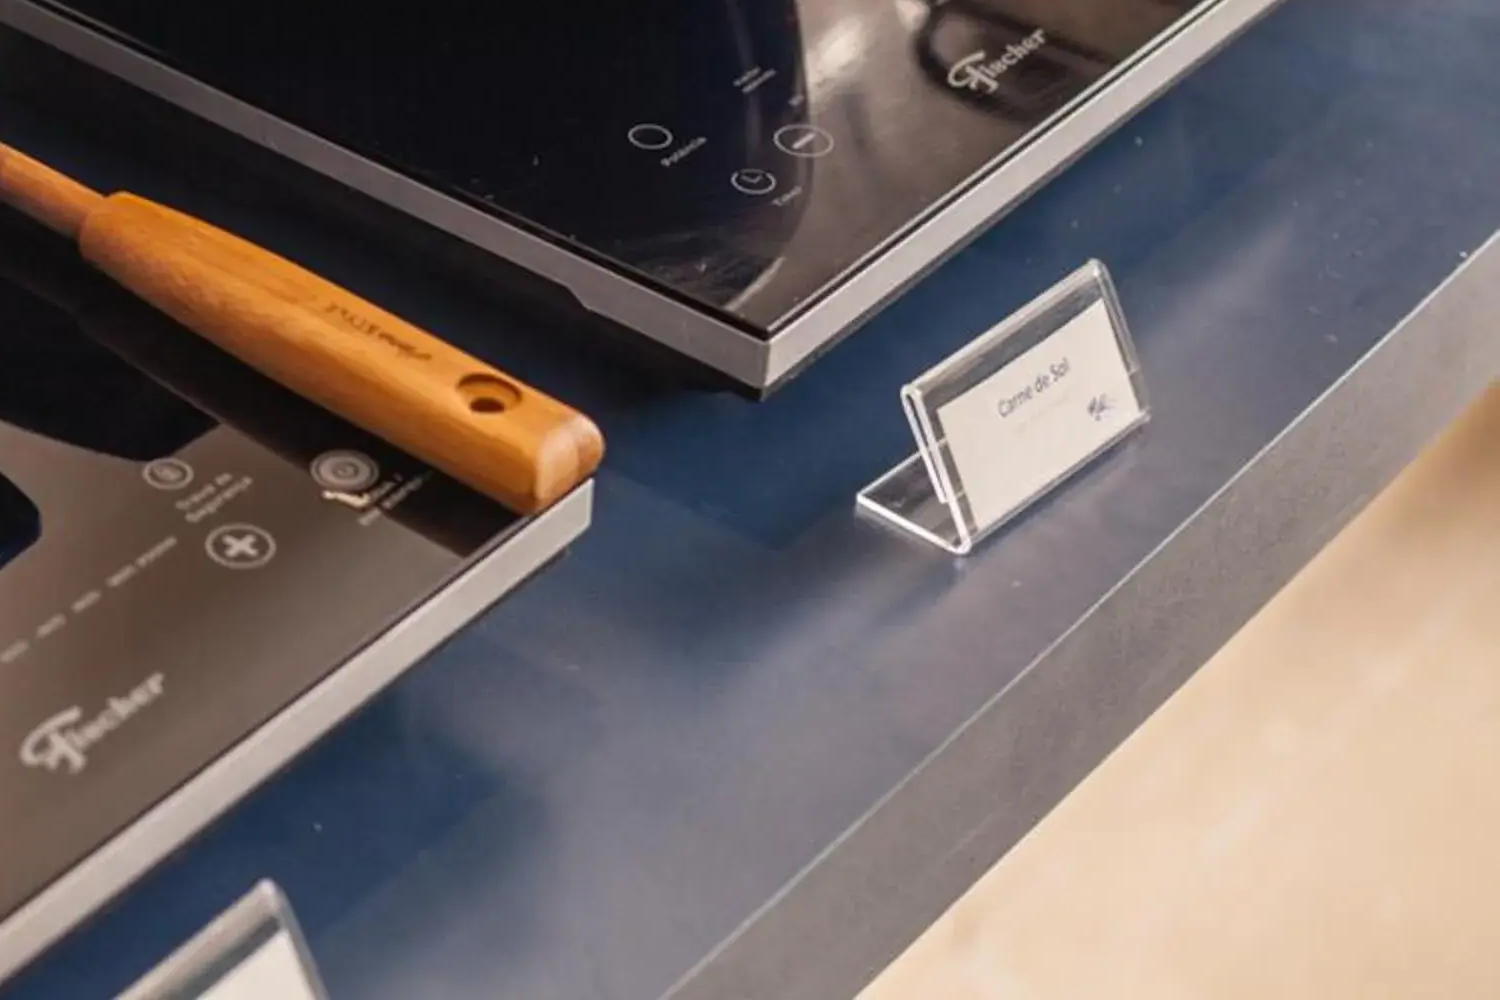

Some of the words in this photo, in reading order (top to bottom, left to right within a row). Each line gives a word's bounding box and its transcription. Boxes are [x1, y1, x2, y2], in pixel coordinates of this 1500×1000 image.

[947, 28, 1046, 94] Fischer
[997, 385, 1033, 418] Carne
[1034, 376, 1051, 393] de
[1049, 356, 1070, 382] Sol
